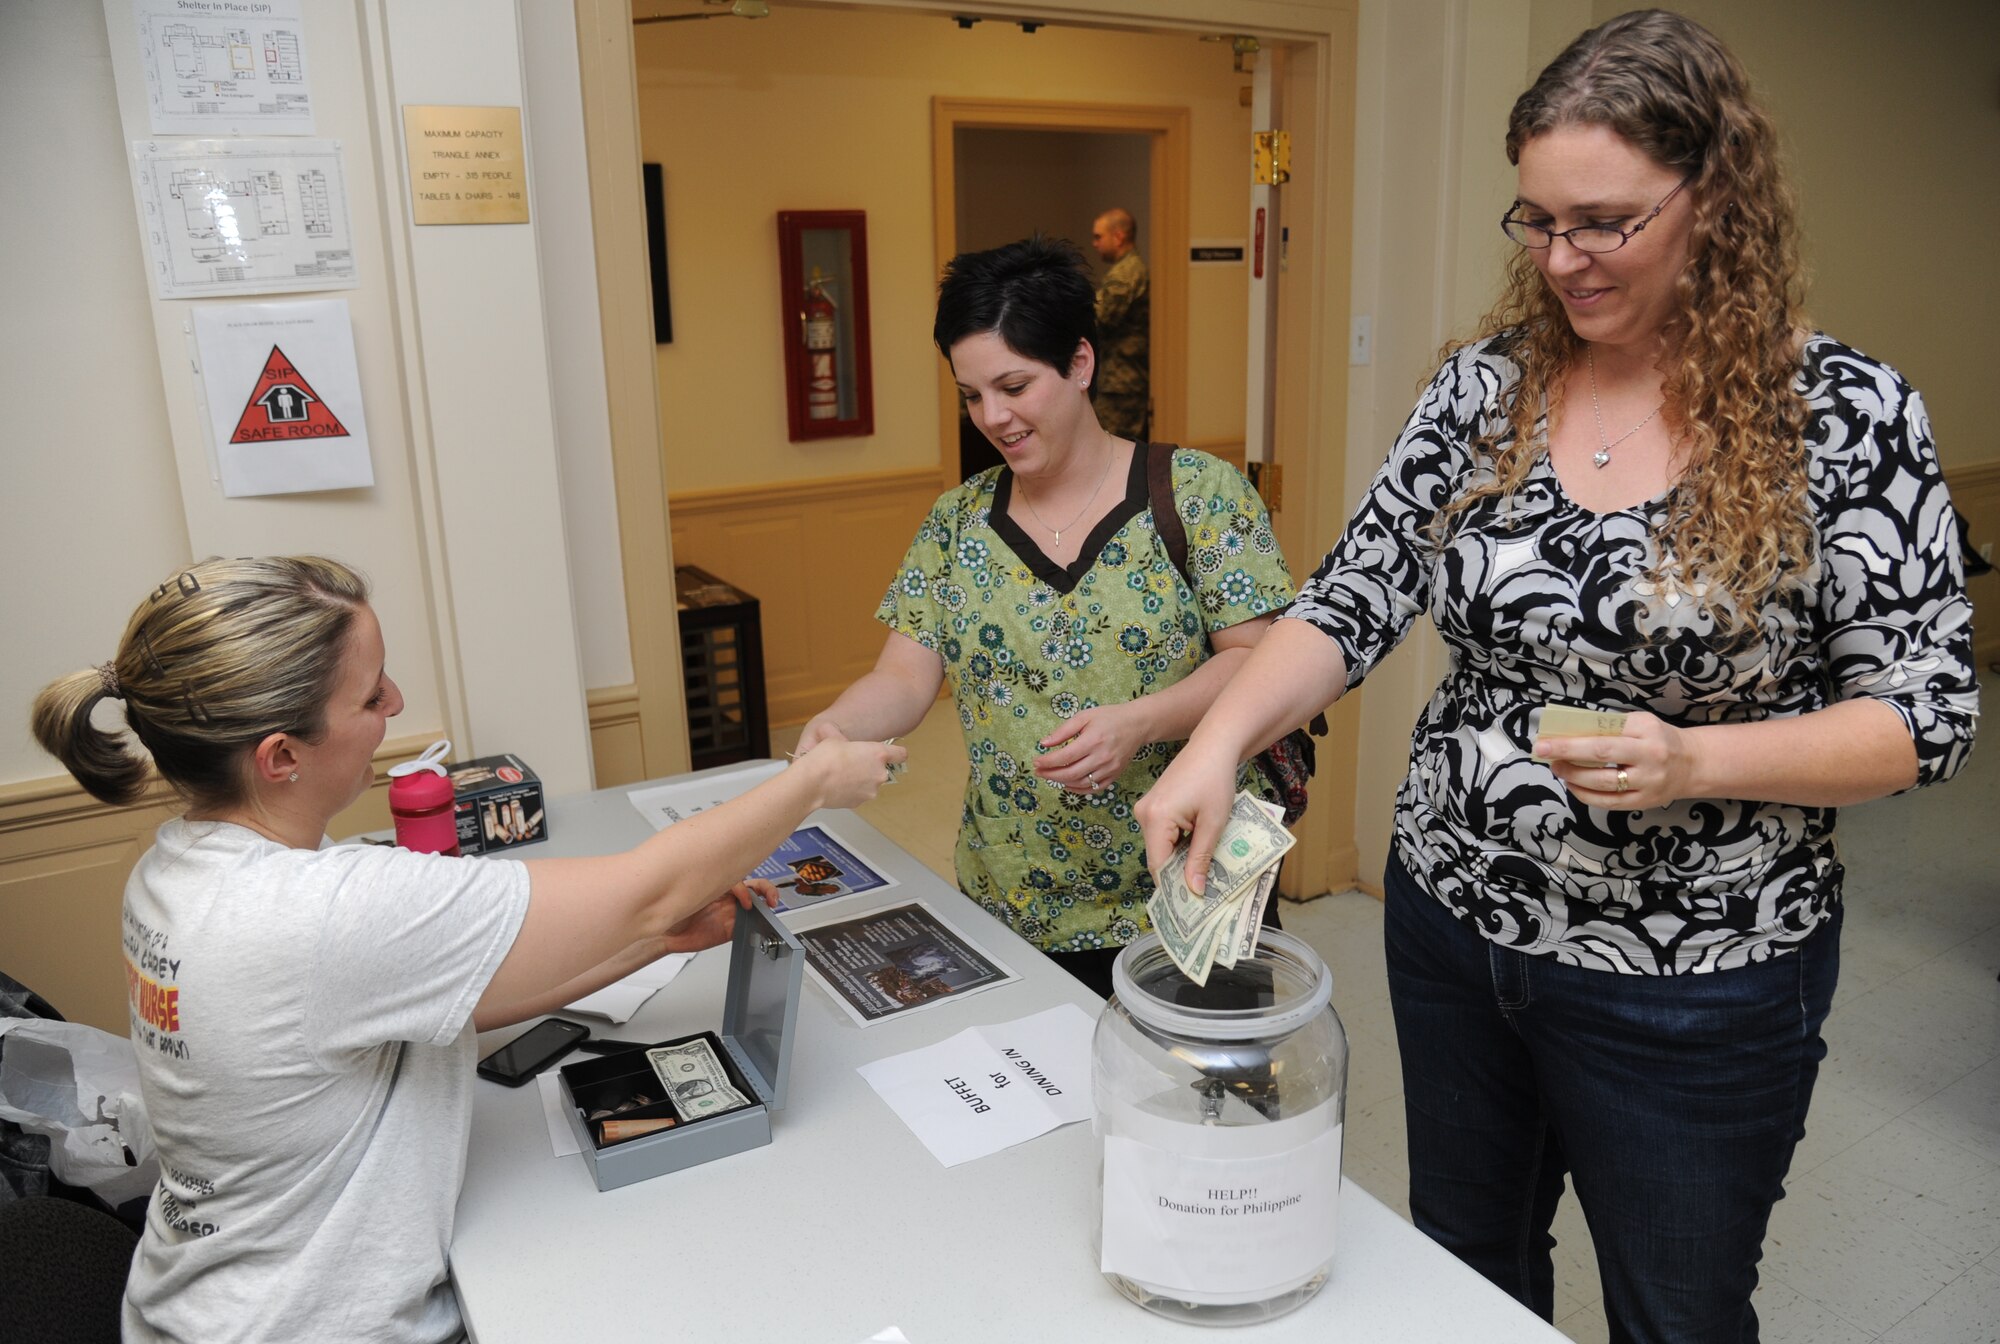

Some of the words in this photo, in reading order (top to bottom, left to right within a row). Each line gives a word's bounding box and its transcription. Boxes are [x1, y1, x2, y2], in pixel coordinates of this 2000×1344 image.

[177, 0, 210, 10] Shelter
[212, 2, 222, 10] In
[224, 3, 248, 12] Place
[250, 4, 272, 14] (SIP)
[424, 130, 461, 138] MAXIMUM
[423, 172, 450, 180] EMPTY
[265, 368, 294, 380] SIP
[240, 427, 283, 440] SAFE
[288, 423, 340, 437] ROOM
[141, 949, 181, 981] CAREY
[140, 973, 180, 1033] NURSE
[1002, 1047, 1022, 1060] IN
[989, 1071, 1016, 1089] for
[1014, 1062, 1063, 1097] DINING
[944, 1076, 992, 1114] BUFFET
[1207, 1188, 1258, 1201] HELP!!
[1158, 1196, 1216, 1216] Donation
[1220, 1205, 1240, 1216] for
[1242, 1193, 1303, 1216] Philippine
